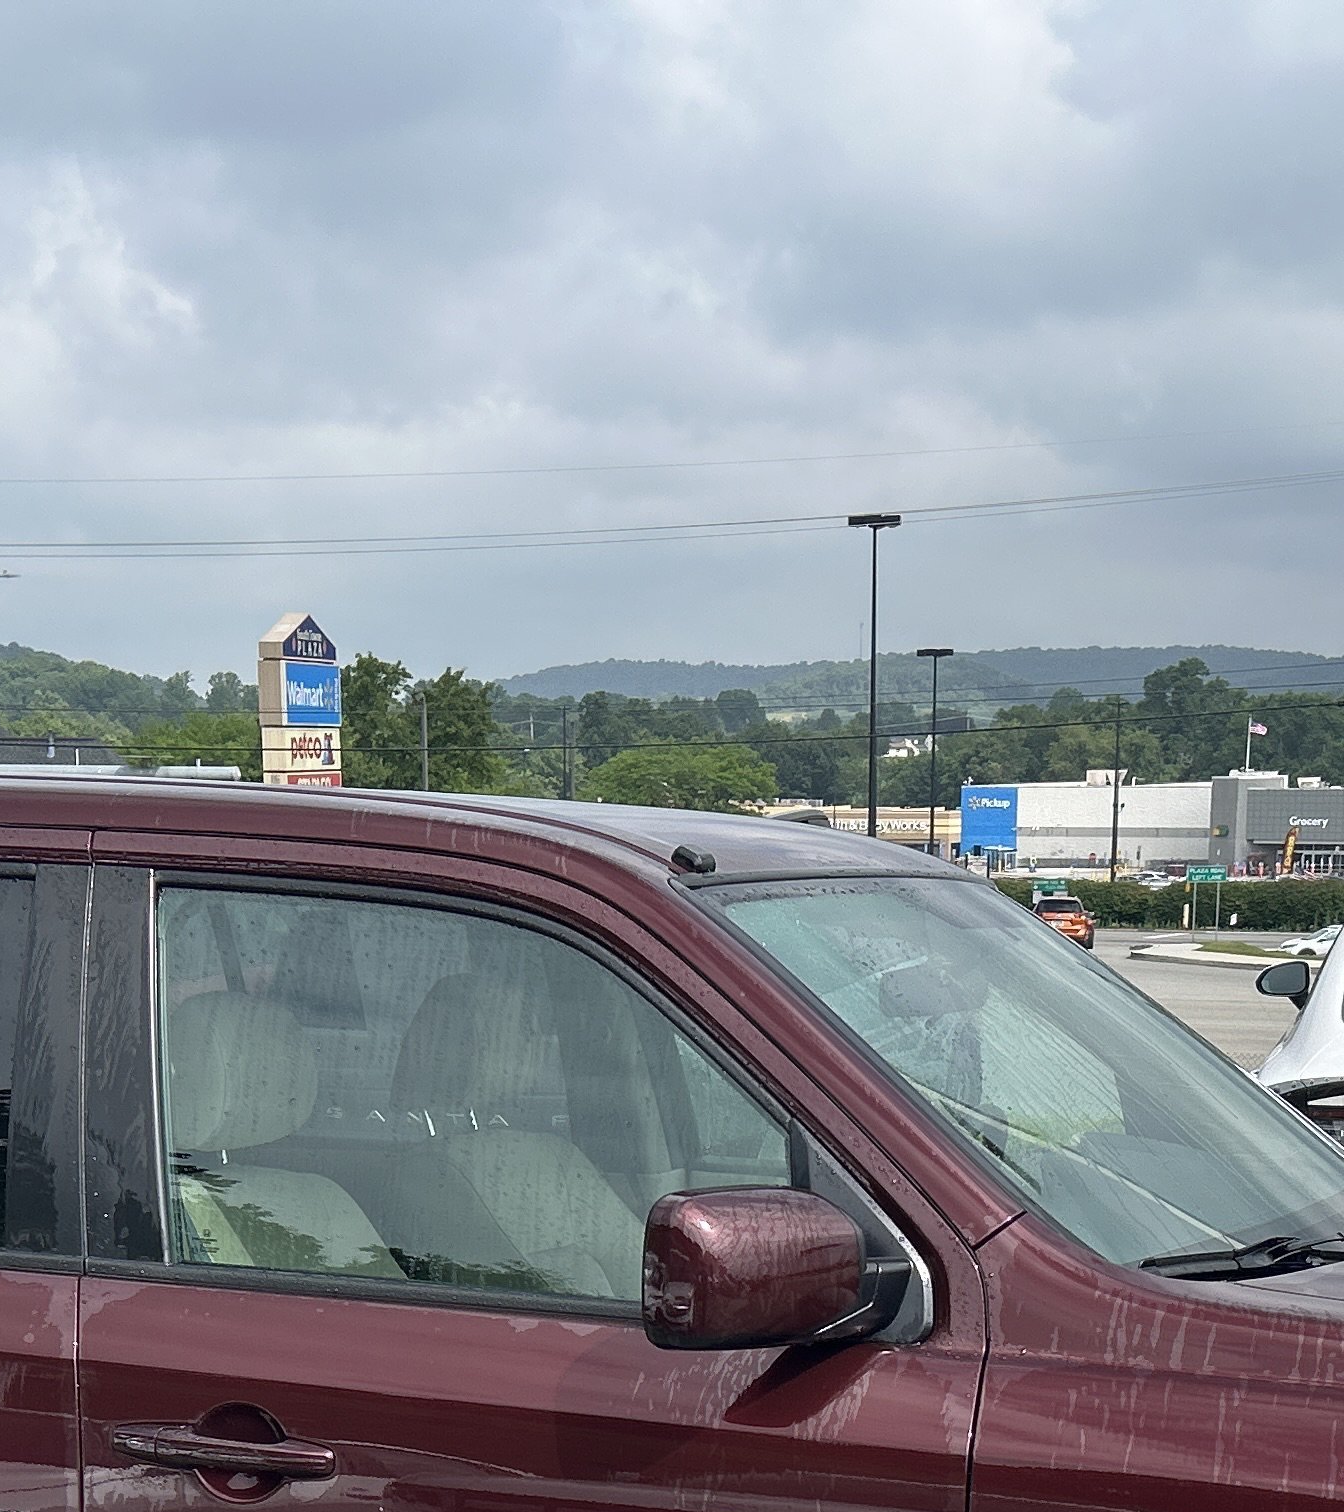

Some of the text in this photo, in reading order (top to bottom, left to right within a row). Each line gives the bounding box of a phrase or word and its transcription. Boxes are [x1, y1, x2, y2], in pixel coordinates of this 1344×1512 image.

[297, 640, 323, 657] PLAZA
[287, 680, 324, 707] Walmart
[291, 733, 322, 766] petco
[980, 797, 1011, 809] Pickup
[890, 819, 927, 831] Works
[1289, 815, 1329, 829] Grocery
